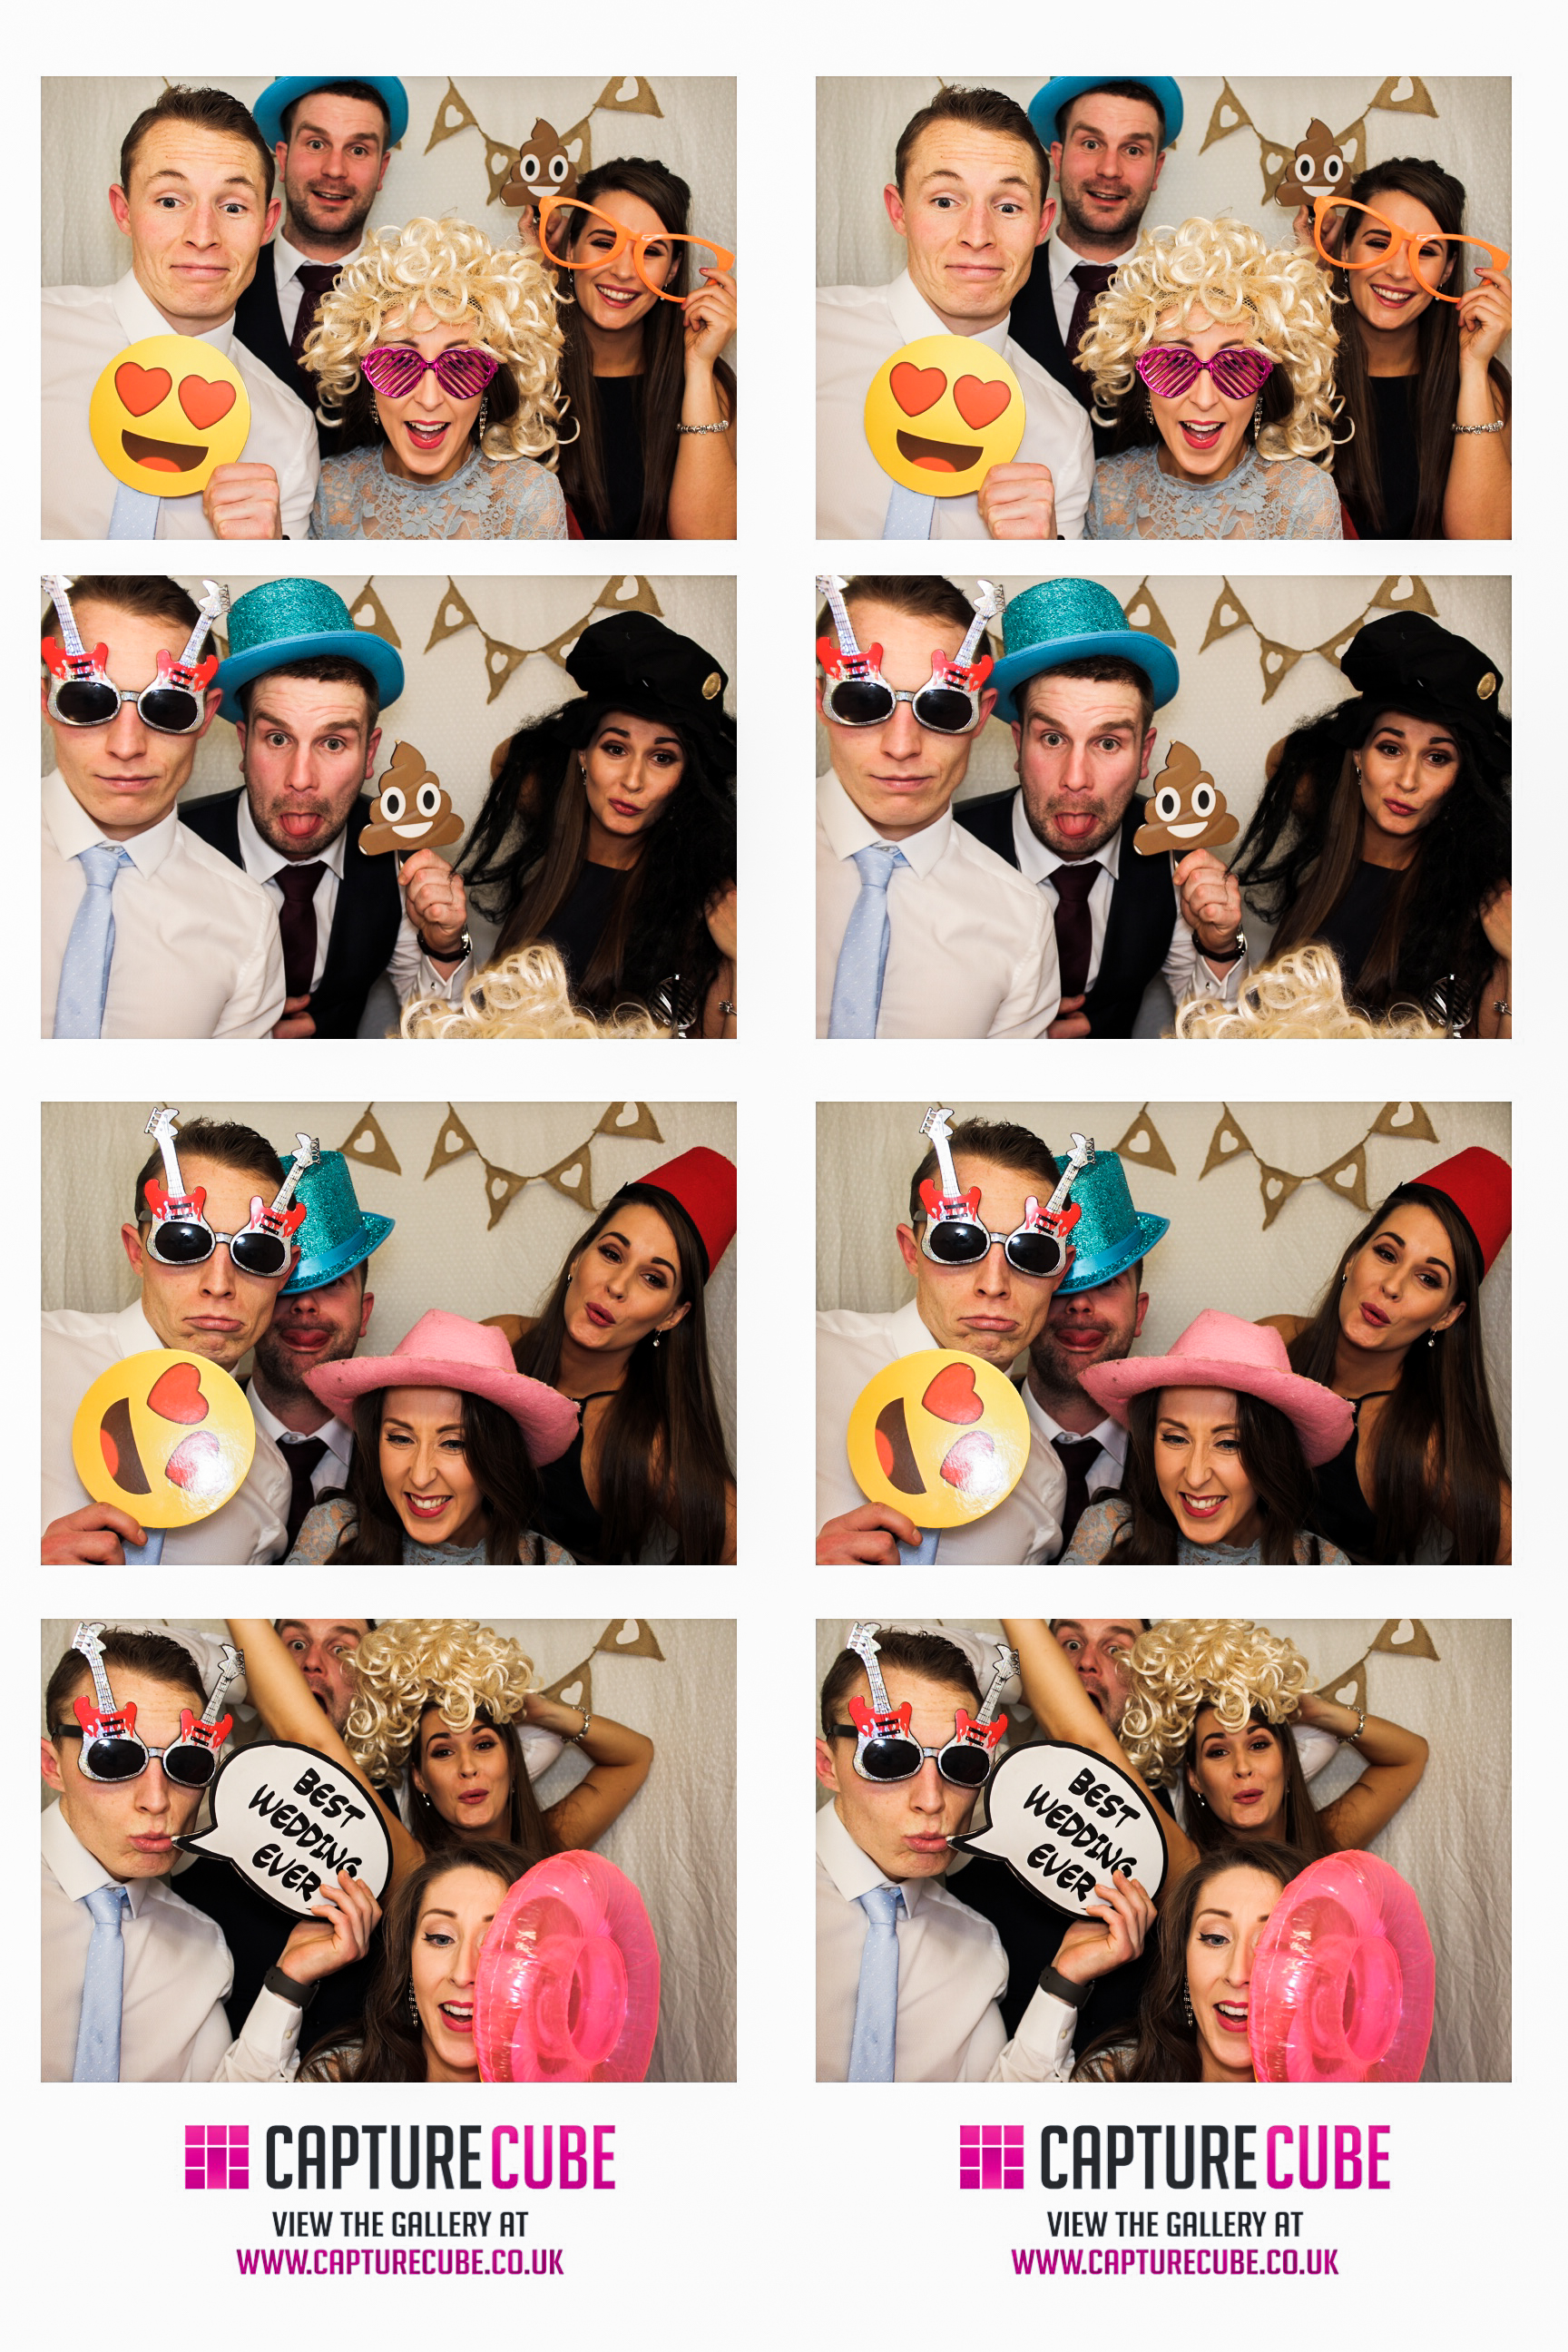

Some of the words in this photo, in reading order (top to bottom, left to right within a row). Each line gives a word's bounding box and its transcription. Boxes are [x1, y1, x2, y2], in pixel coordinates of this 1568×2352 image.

[292, 1767, 367, 1828] BEST
[1067, 1767, 1142, 1828] BEST
[248, 1783, 363, 1879] WEDDING
[1023, 1783, 1138, 1879] WEDDING
[251, 1843, 322, 1903] EVER
[1026, 1843, 1097, 1903] EVER
